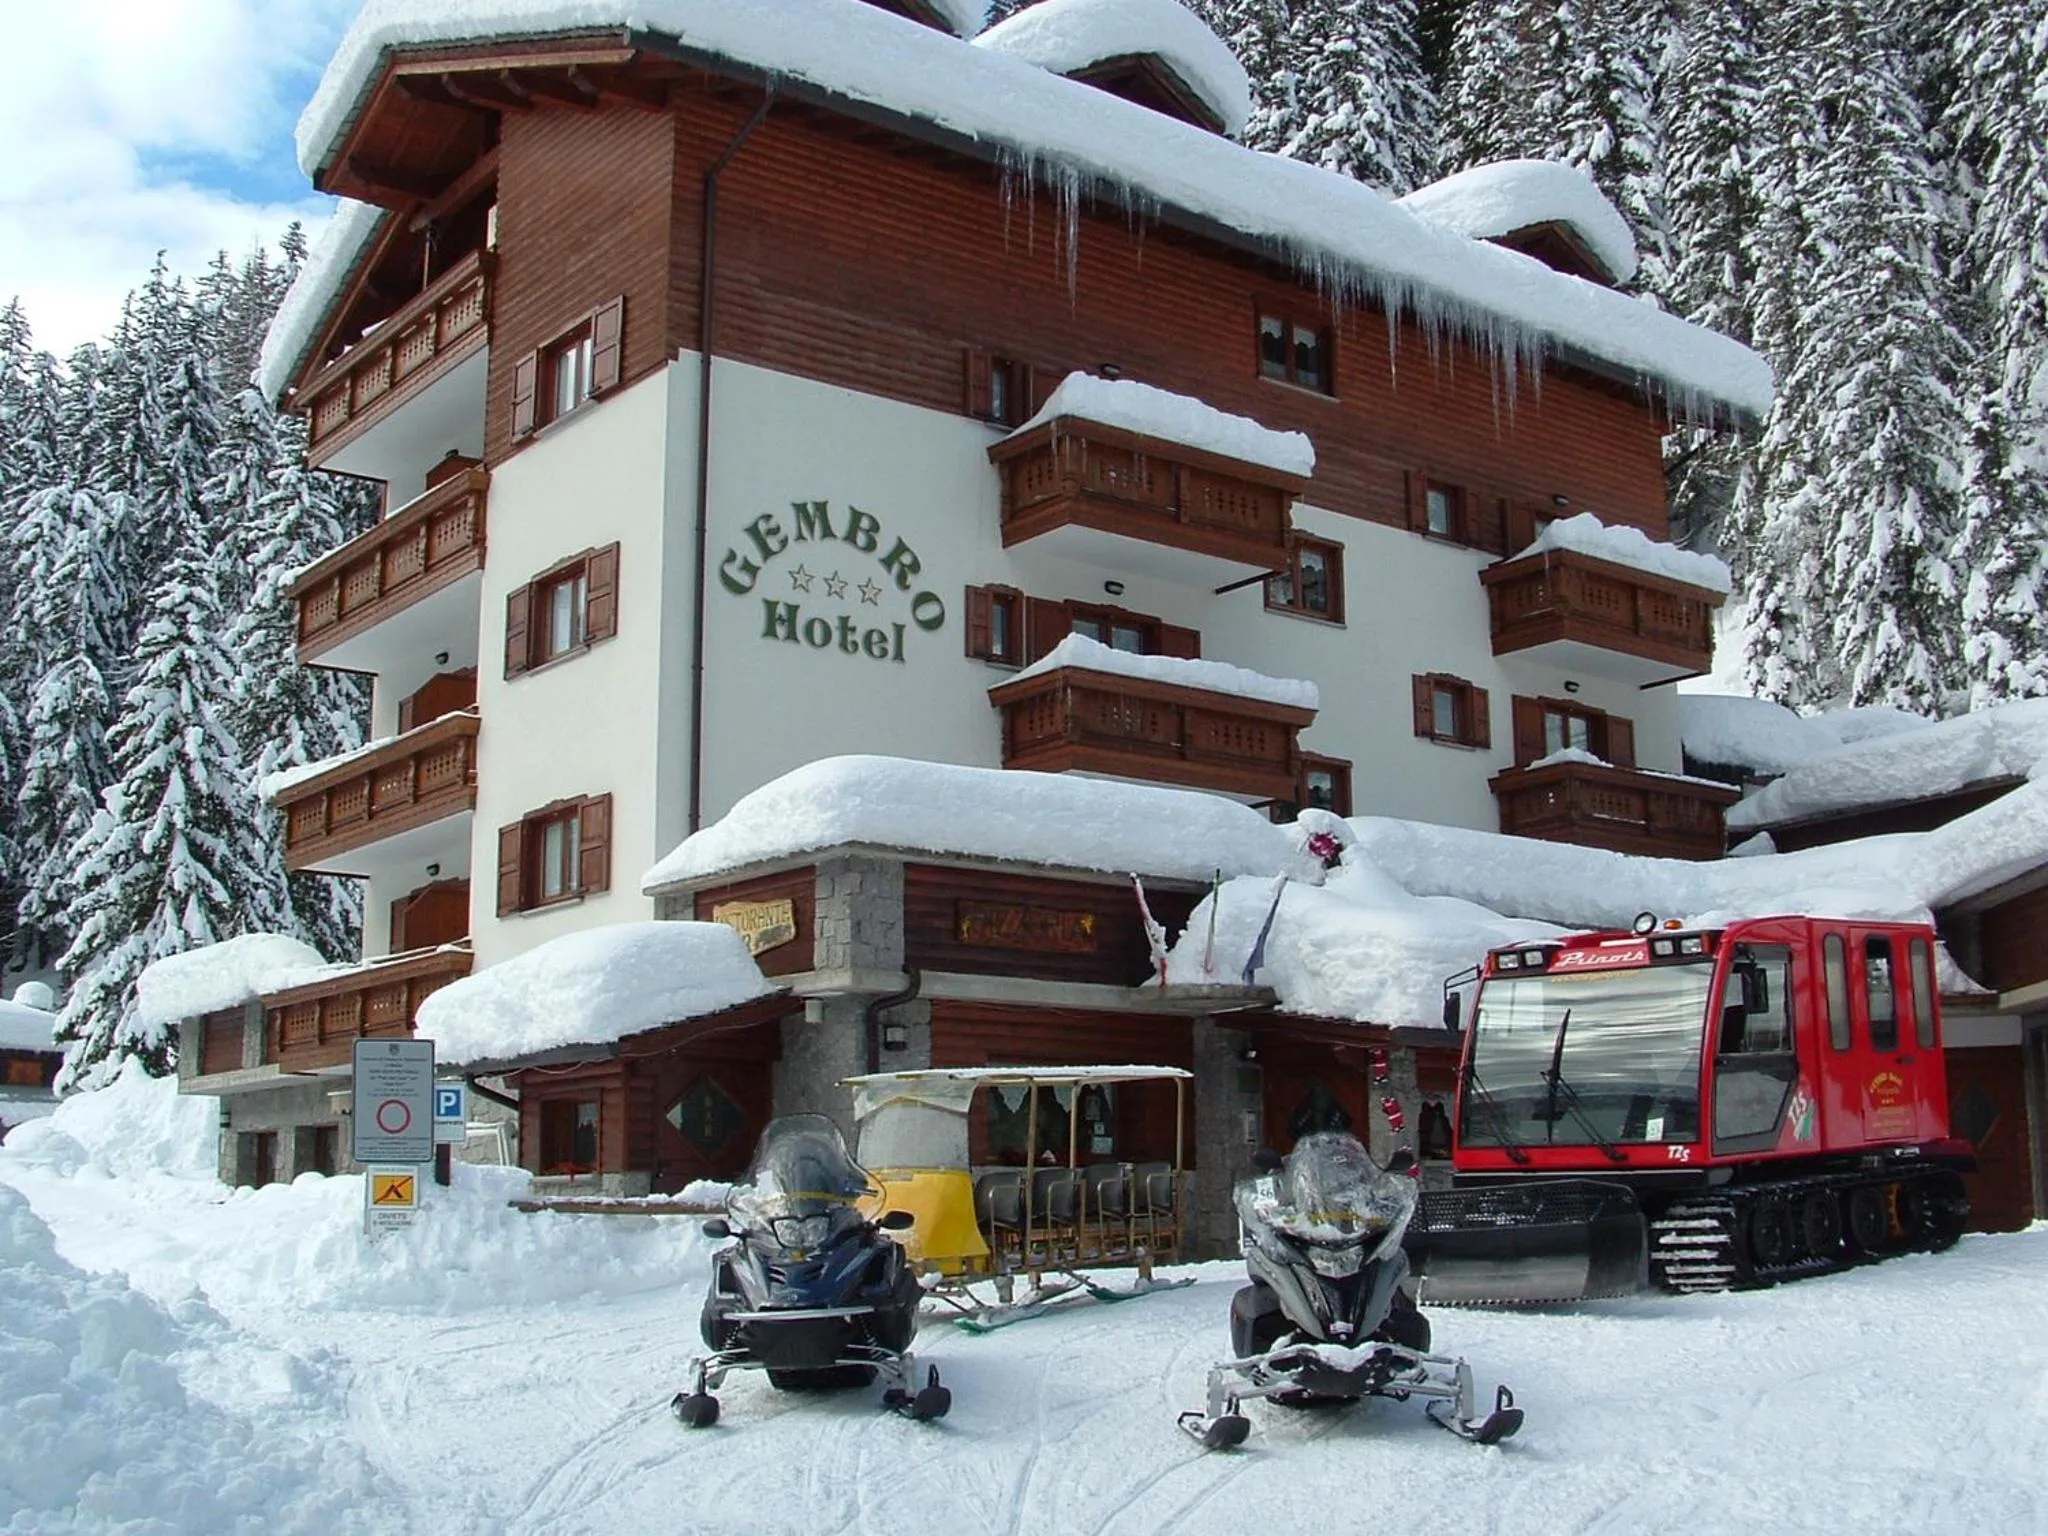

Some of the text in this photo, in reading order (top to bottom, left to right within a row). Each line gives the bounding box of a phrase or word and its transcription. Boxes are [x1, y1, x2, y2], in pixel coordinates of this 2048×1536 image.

[718, 500, 945, 632] GEMBRO
[761, 598, 906, 663] Hotel
[1554, 951, 1645, 967] Prinoth
[440, 1091, 457, 1115] P
